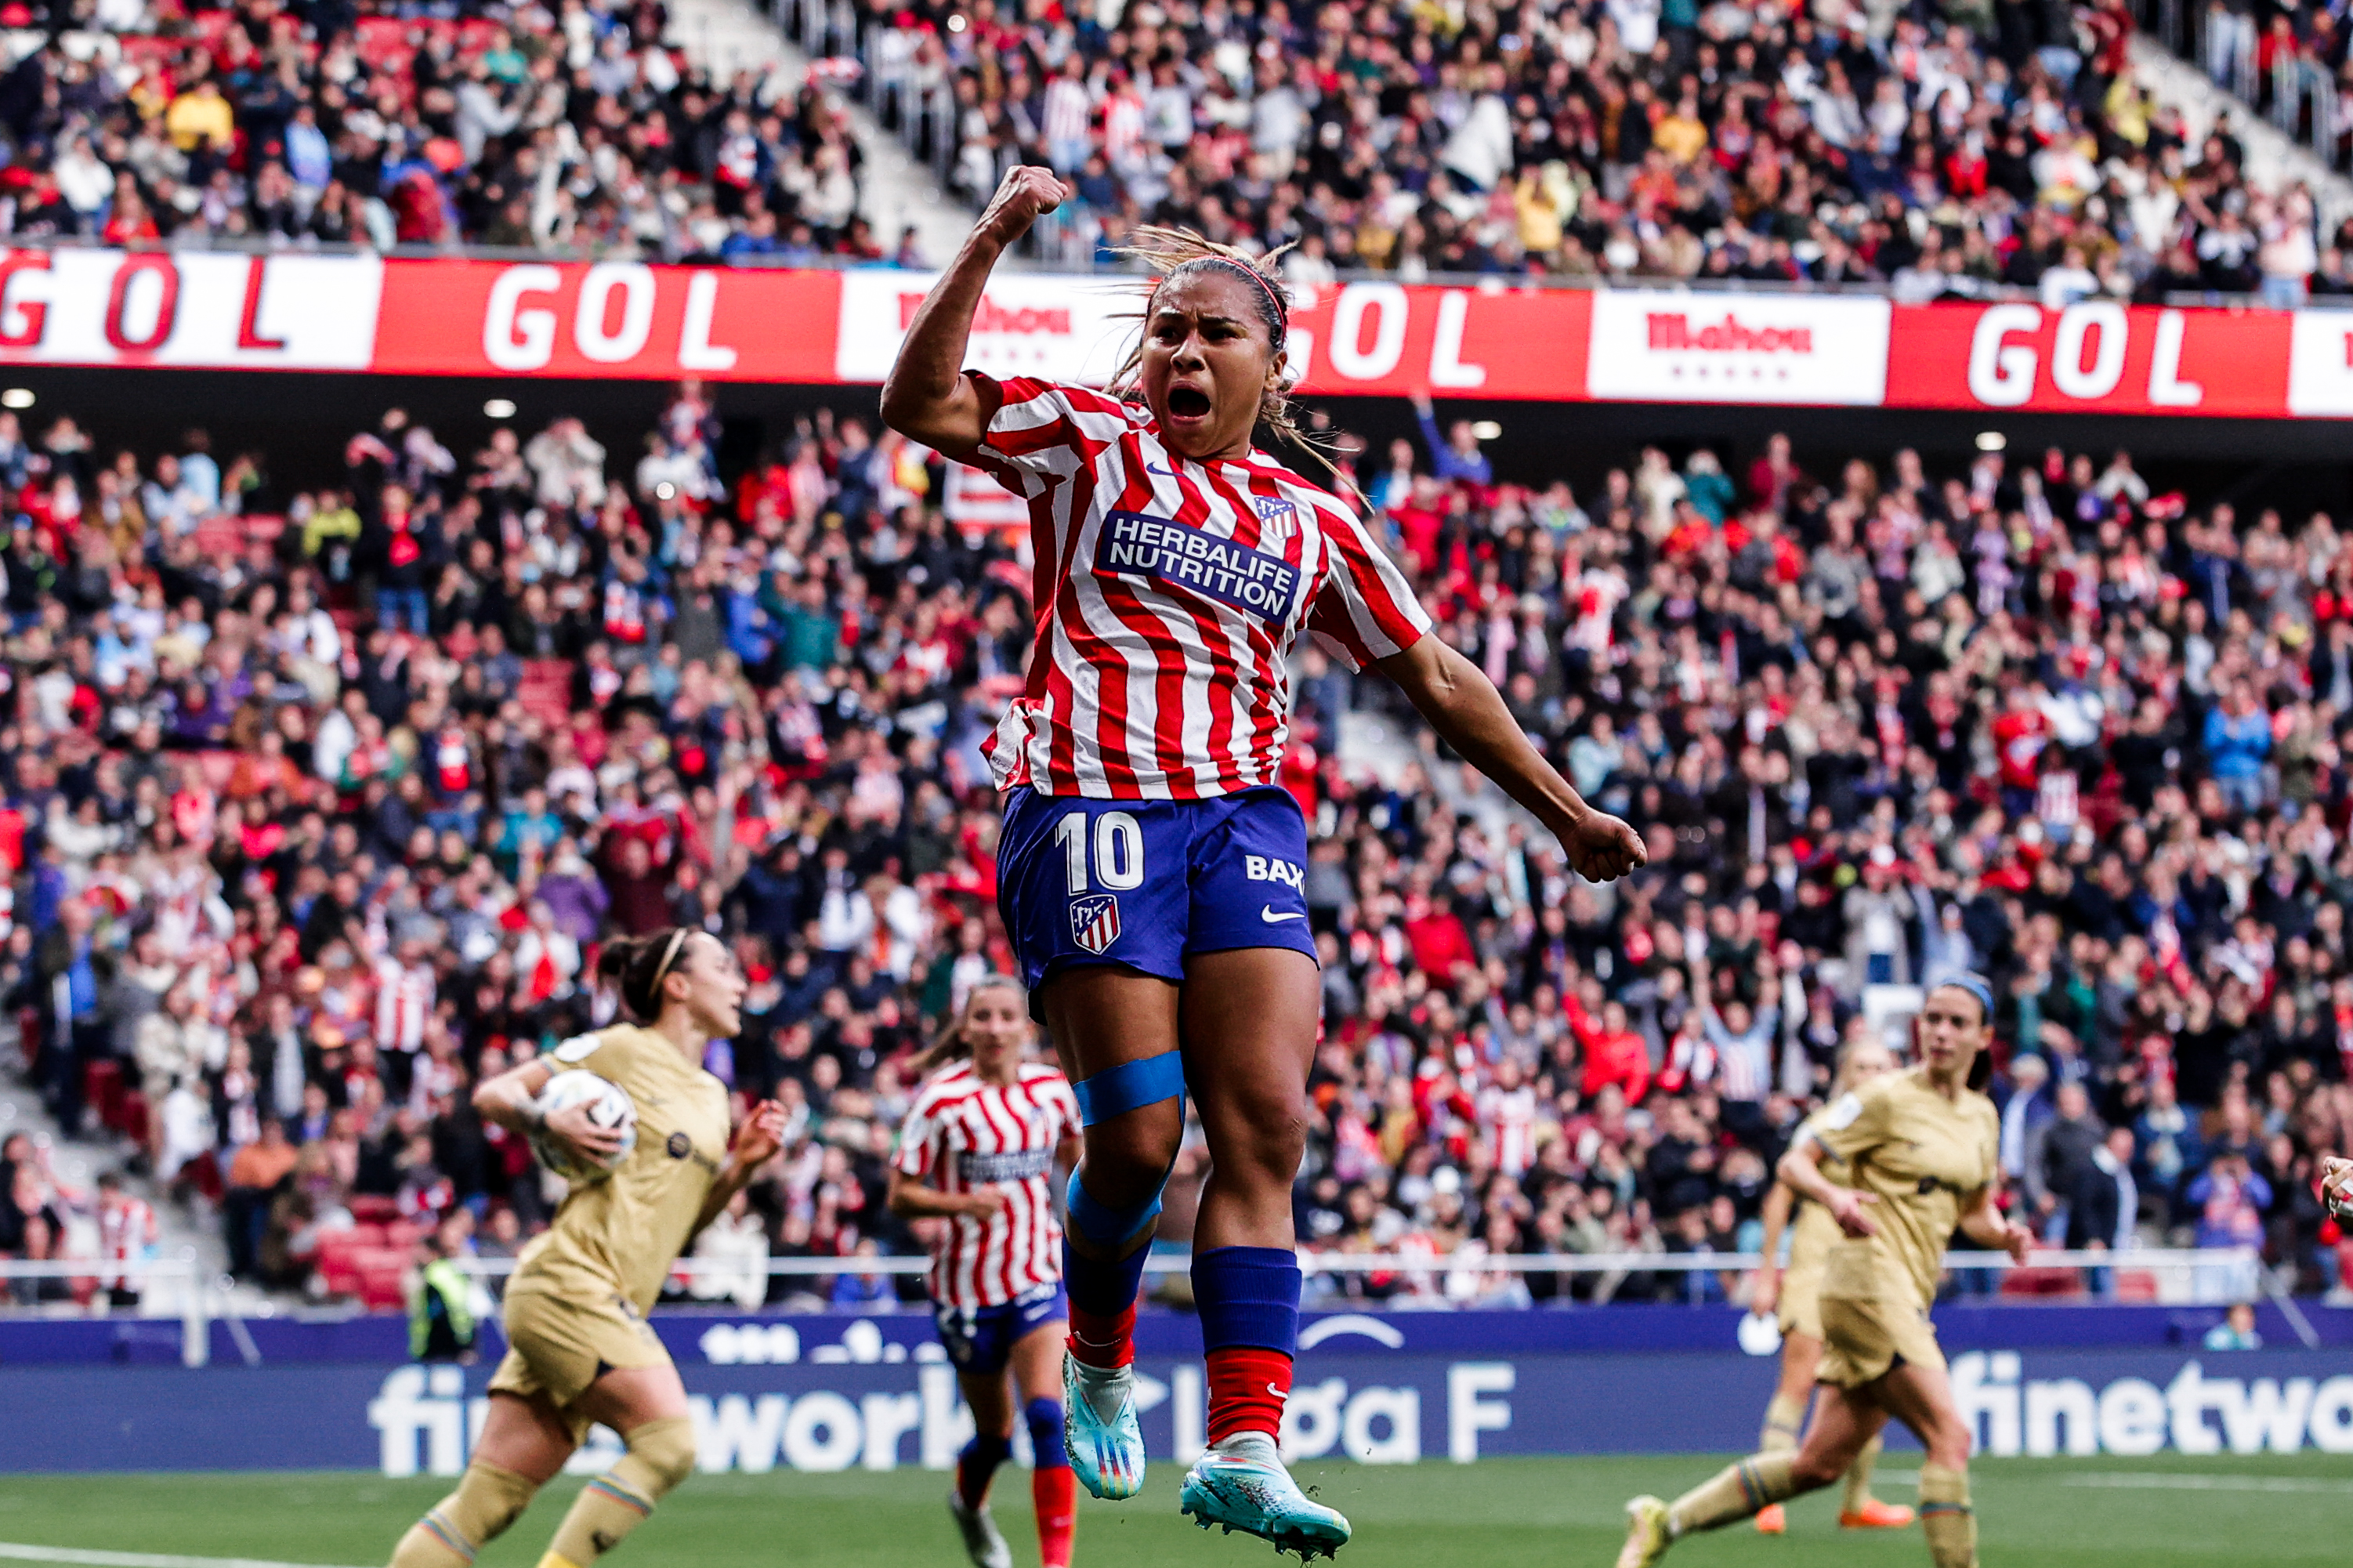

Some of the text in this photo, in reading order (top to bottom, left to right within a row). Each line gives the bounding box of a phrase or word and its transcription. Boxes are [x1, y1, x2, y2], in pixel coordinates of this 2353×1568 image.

[0, 248, 287, 351] GOL
[483, 263, 737, 371] GOL
[1967, 301, 2203, 407] GOL
[1110, 541, 1287, 617] NUTRITION
[1113, 518, 1293, 593] HERBALIFE
[1055, 811, 1144, 896] 10
[1173, 1363, 1421, 1467] Lga
[1447, 1361, 1515, 1463] F
